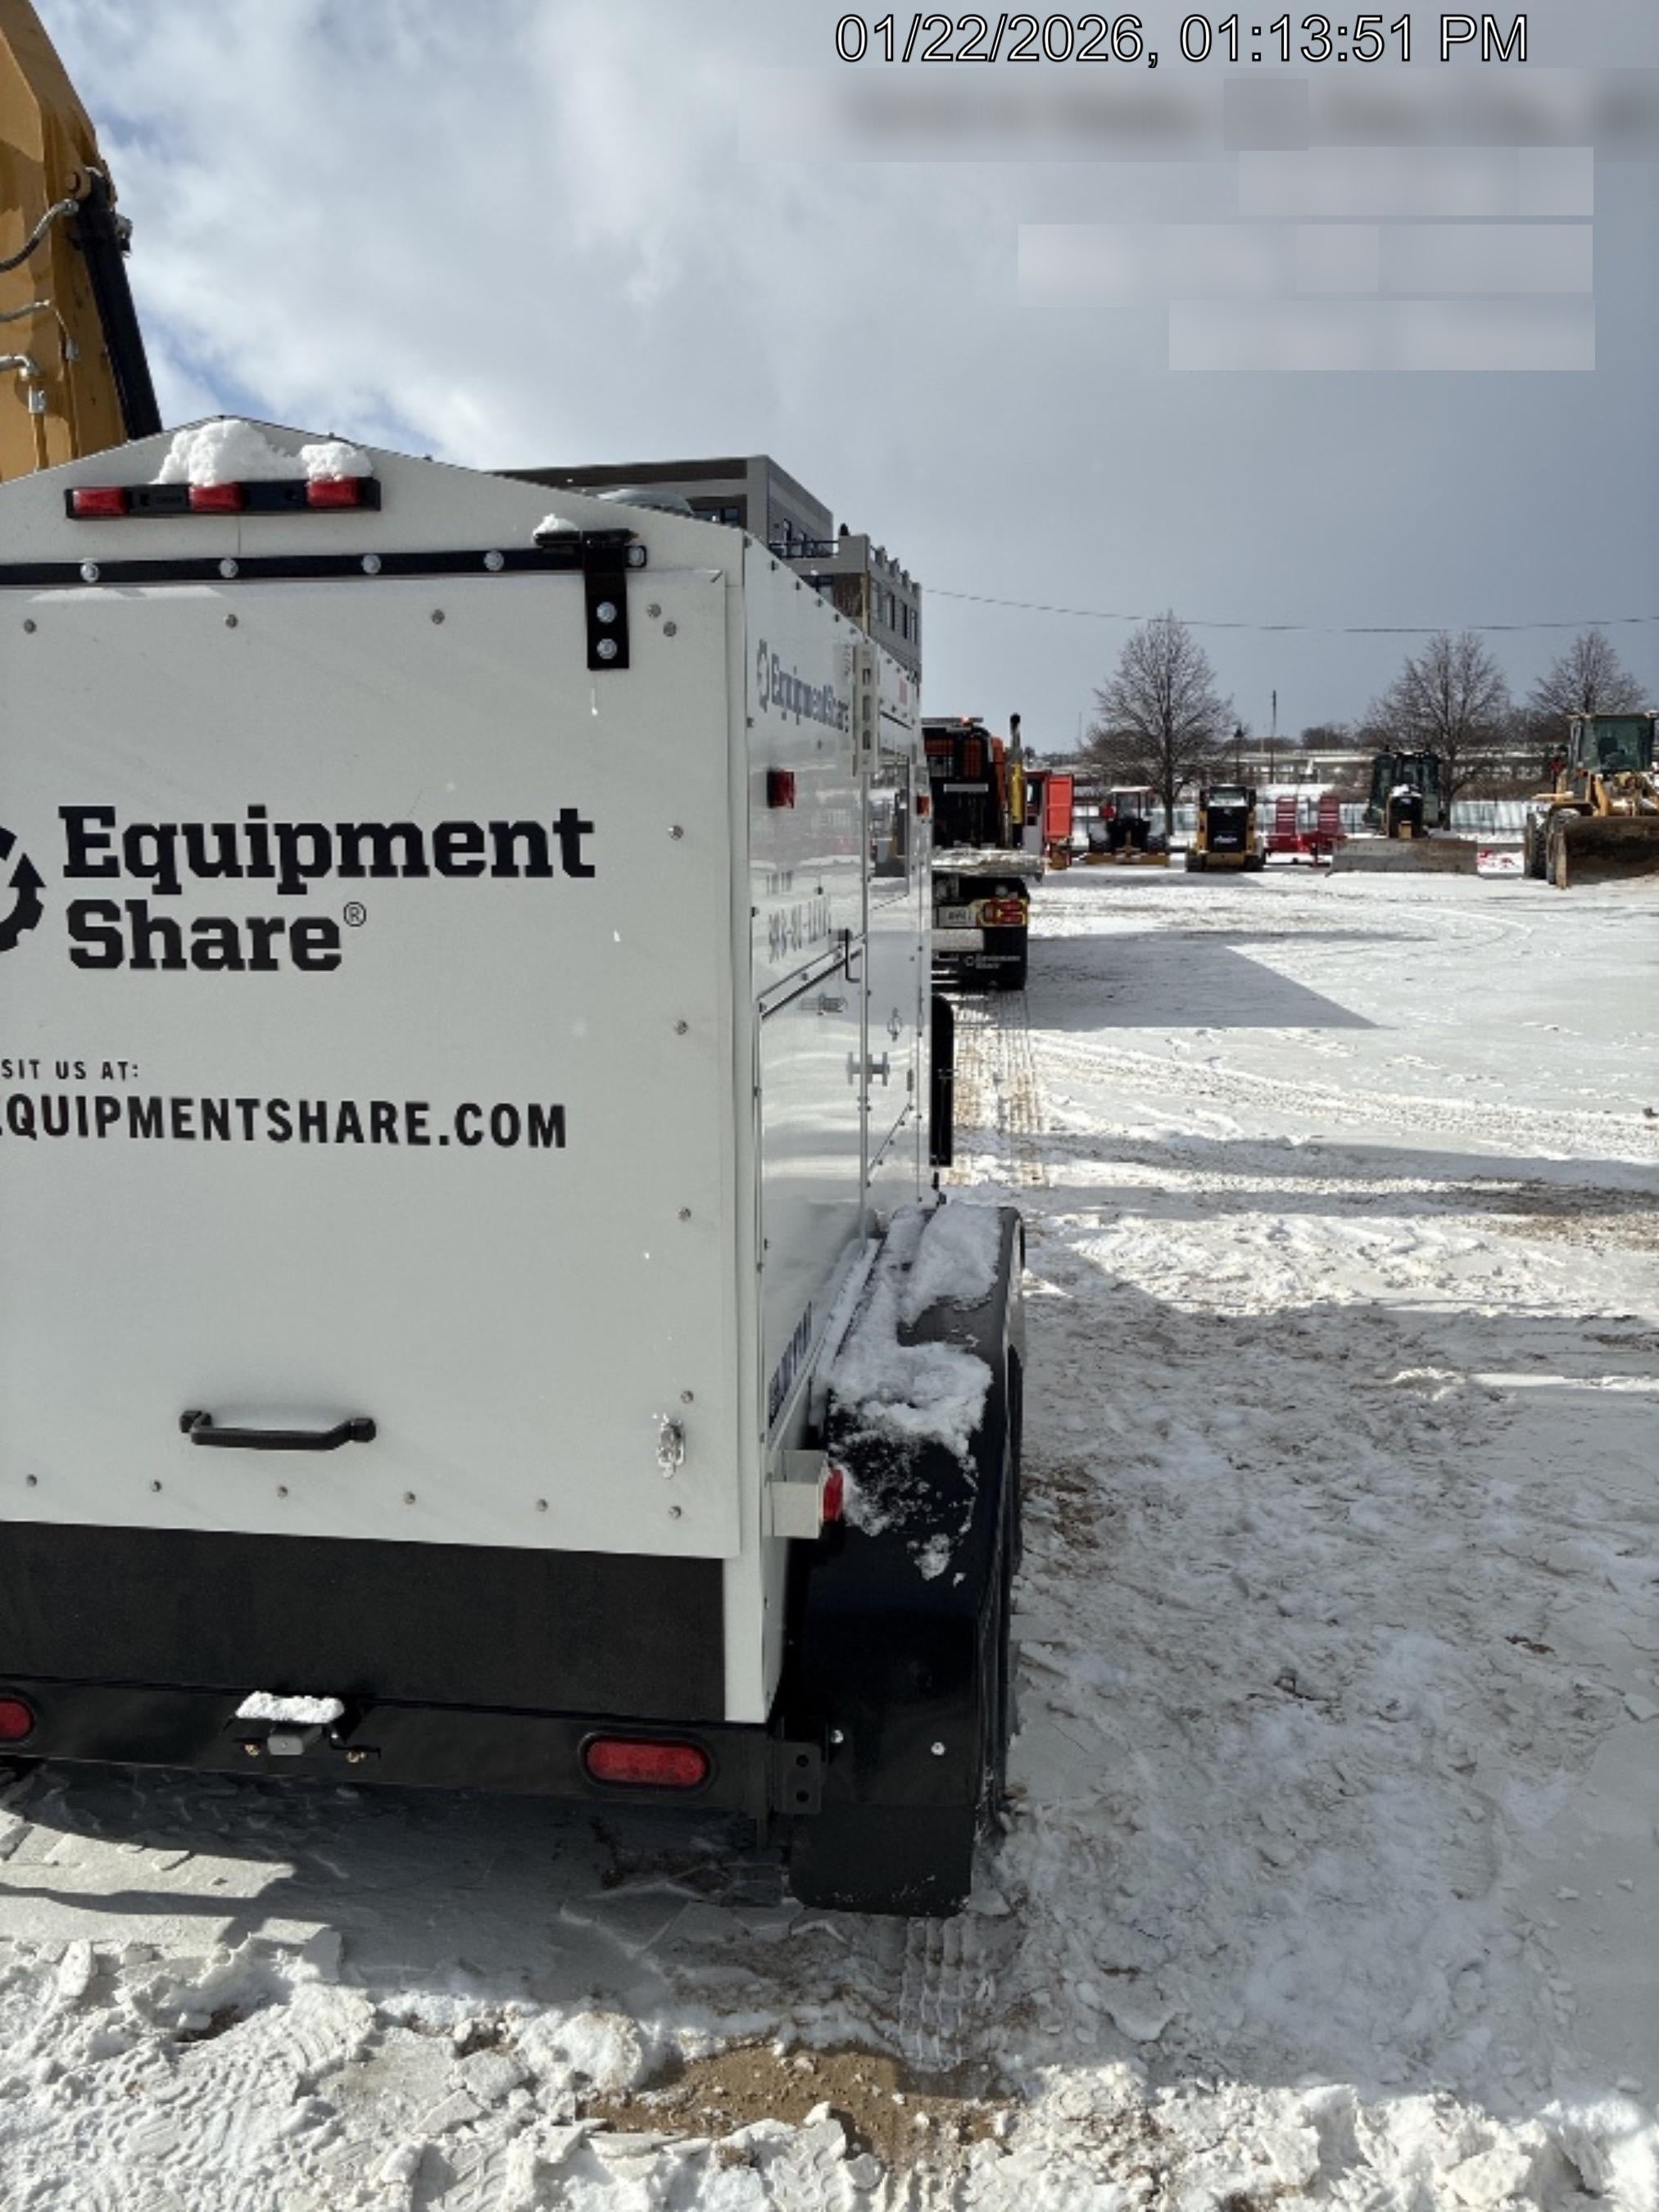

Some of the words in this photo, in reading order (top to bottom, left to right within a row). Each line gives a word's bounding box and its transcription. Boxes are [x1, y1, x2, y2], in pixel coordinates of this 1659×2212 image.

[58, 805, 596, 895] Equipment
[55, 1060, 87, 1080] US
[101, 1060, 138, 1081] AT:
[0, 1093, 566, 1149] QUIPMENTSHARE.COM
